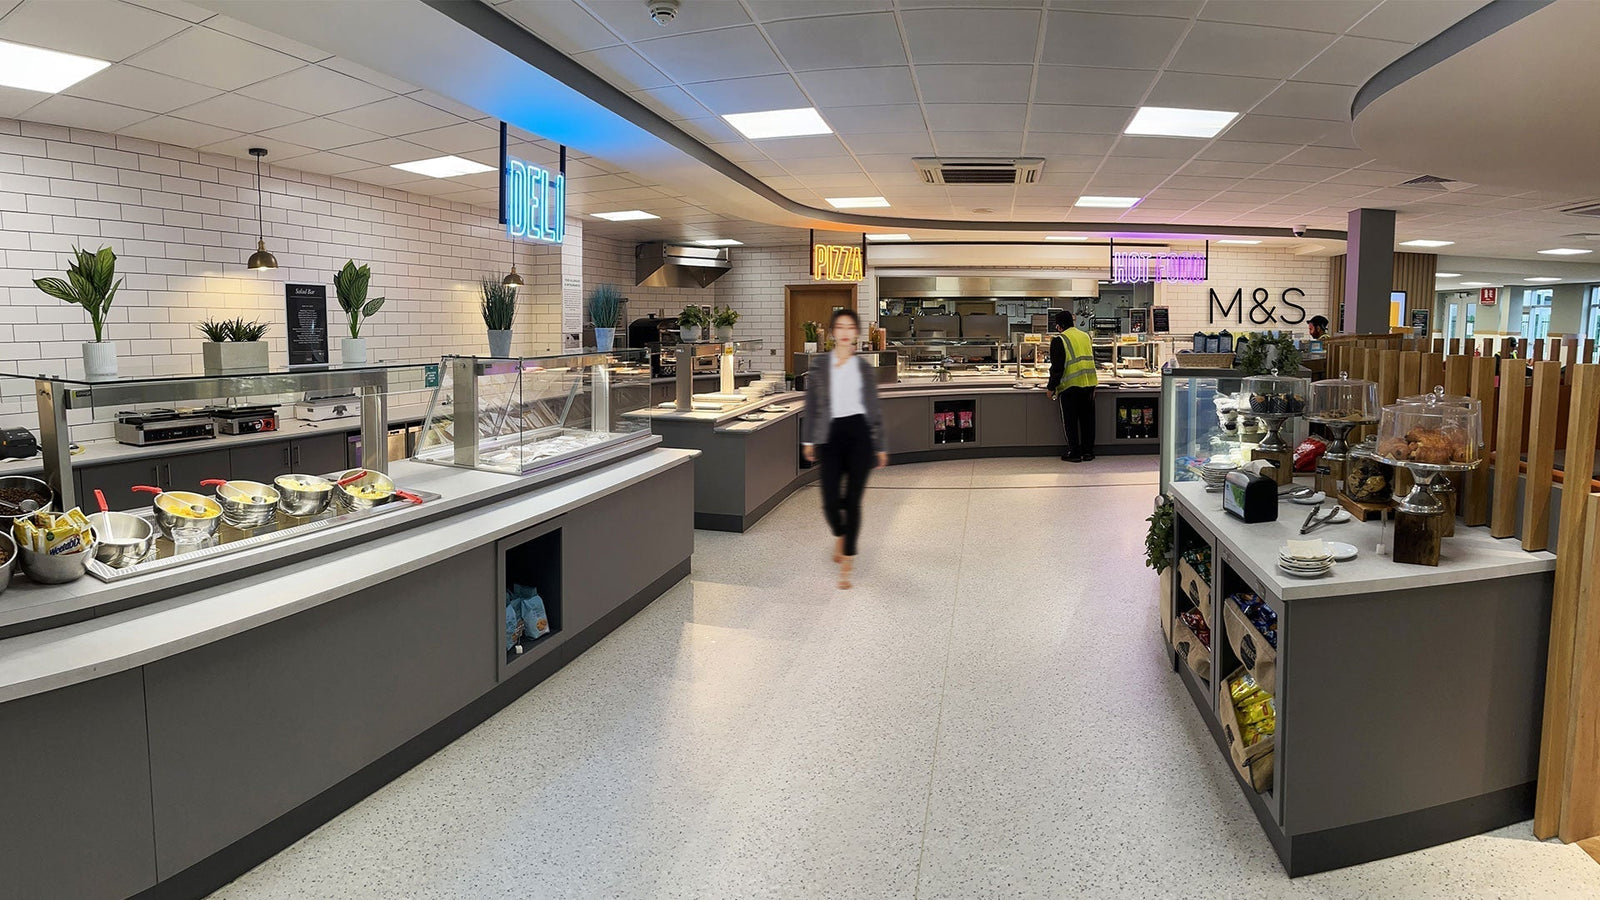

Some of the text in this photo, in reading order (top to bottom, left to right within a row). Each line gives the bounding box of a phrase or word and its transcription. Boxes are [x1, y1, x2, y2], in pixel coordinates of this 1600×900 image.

[509, 159, 564, 243] DELI
[815, 244, 863, 281] PIZZA
[1114, 252, 1206, 285] HOT FOOD
[1209, 287, 1306, 324] M&S
[49, 536, 81, 556] Weetabix
